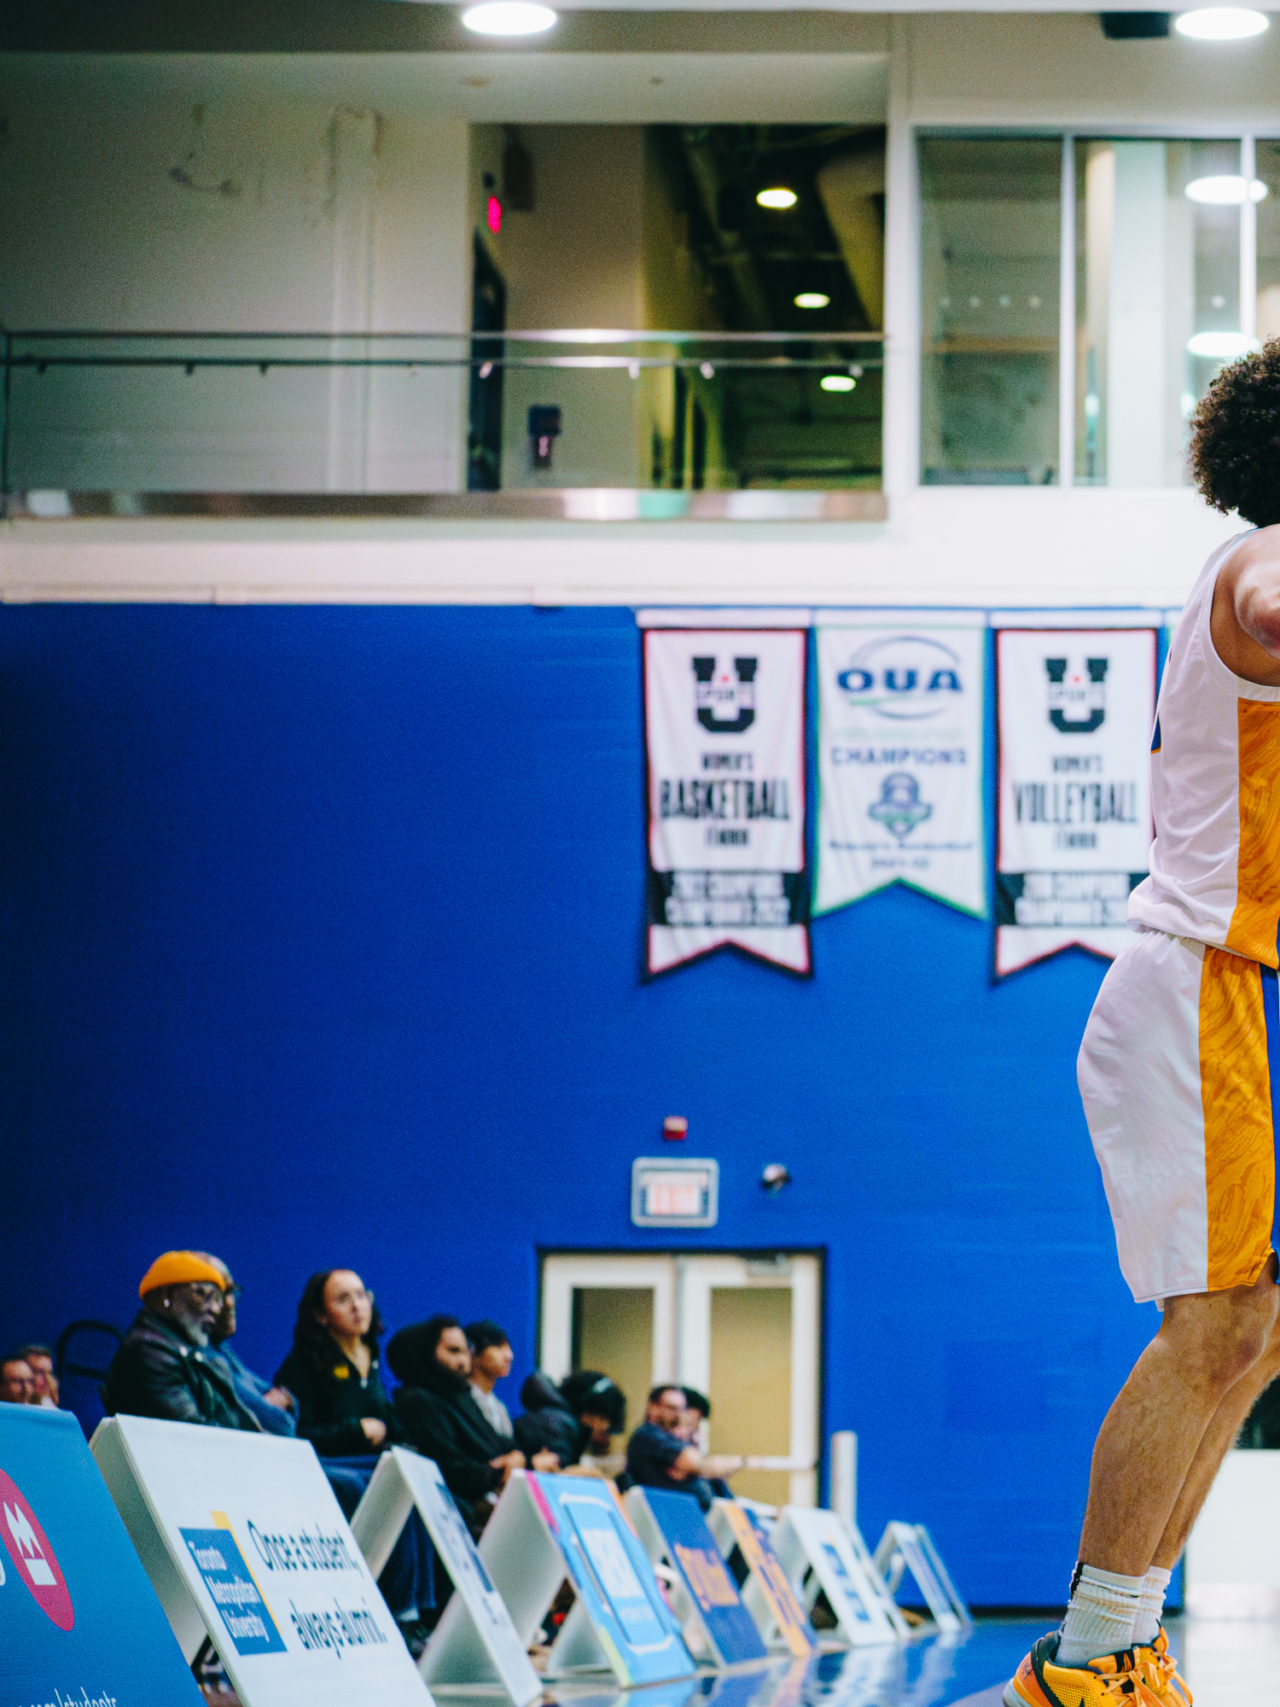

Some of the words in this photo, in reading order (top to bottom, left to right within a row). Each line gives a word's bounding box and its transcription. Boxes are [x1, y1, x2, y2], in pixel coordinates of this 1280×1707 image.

[837, 669, 963, 692] OUA
[832, 748, 967, 764] CHAMPIONS
[660, 779, 789, 819] BASKETBALL
[1014, 782, 1138, 823] VOLLEYBALL
[247, 1519, 298, 1571] Once
[290, 1535, 308, 1570] a
[289, 1598, 342, 1660] always
